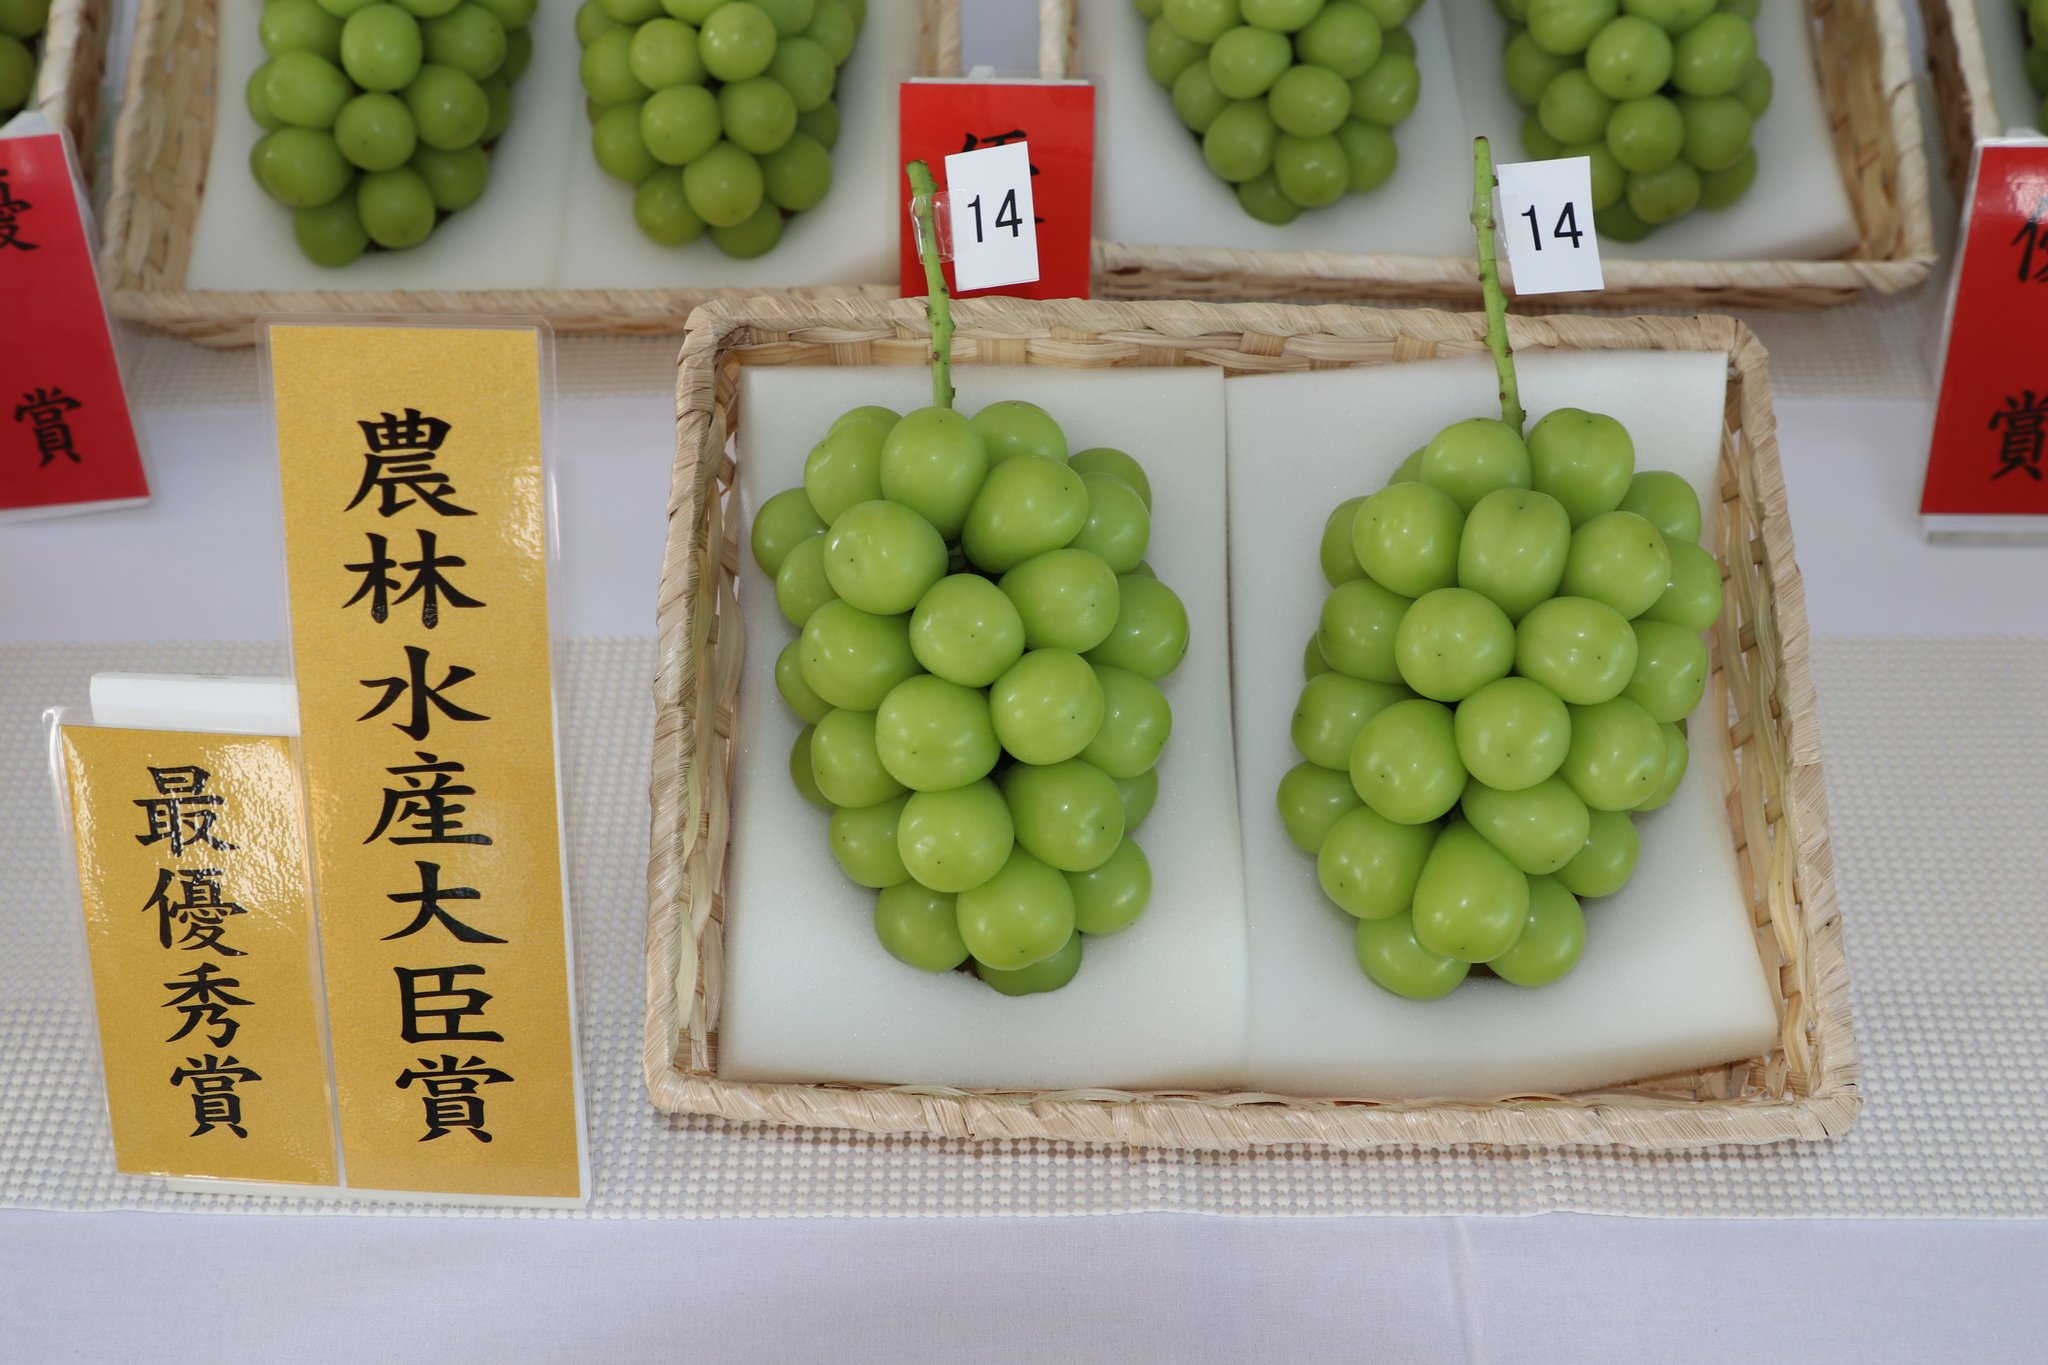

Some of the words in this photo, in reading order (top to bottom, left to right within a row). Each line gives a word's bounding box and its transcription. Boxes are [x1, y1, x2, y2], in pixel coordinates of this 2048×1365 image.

[966, 188, 1024, 243] 14
[1520, 201, 1584, 251] 14
[343, 407, 515, 1144] 農林水産大臣賞
[133, 765, 263, 1140] 最優秀賞
